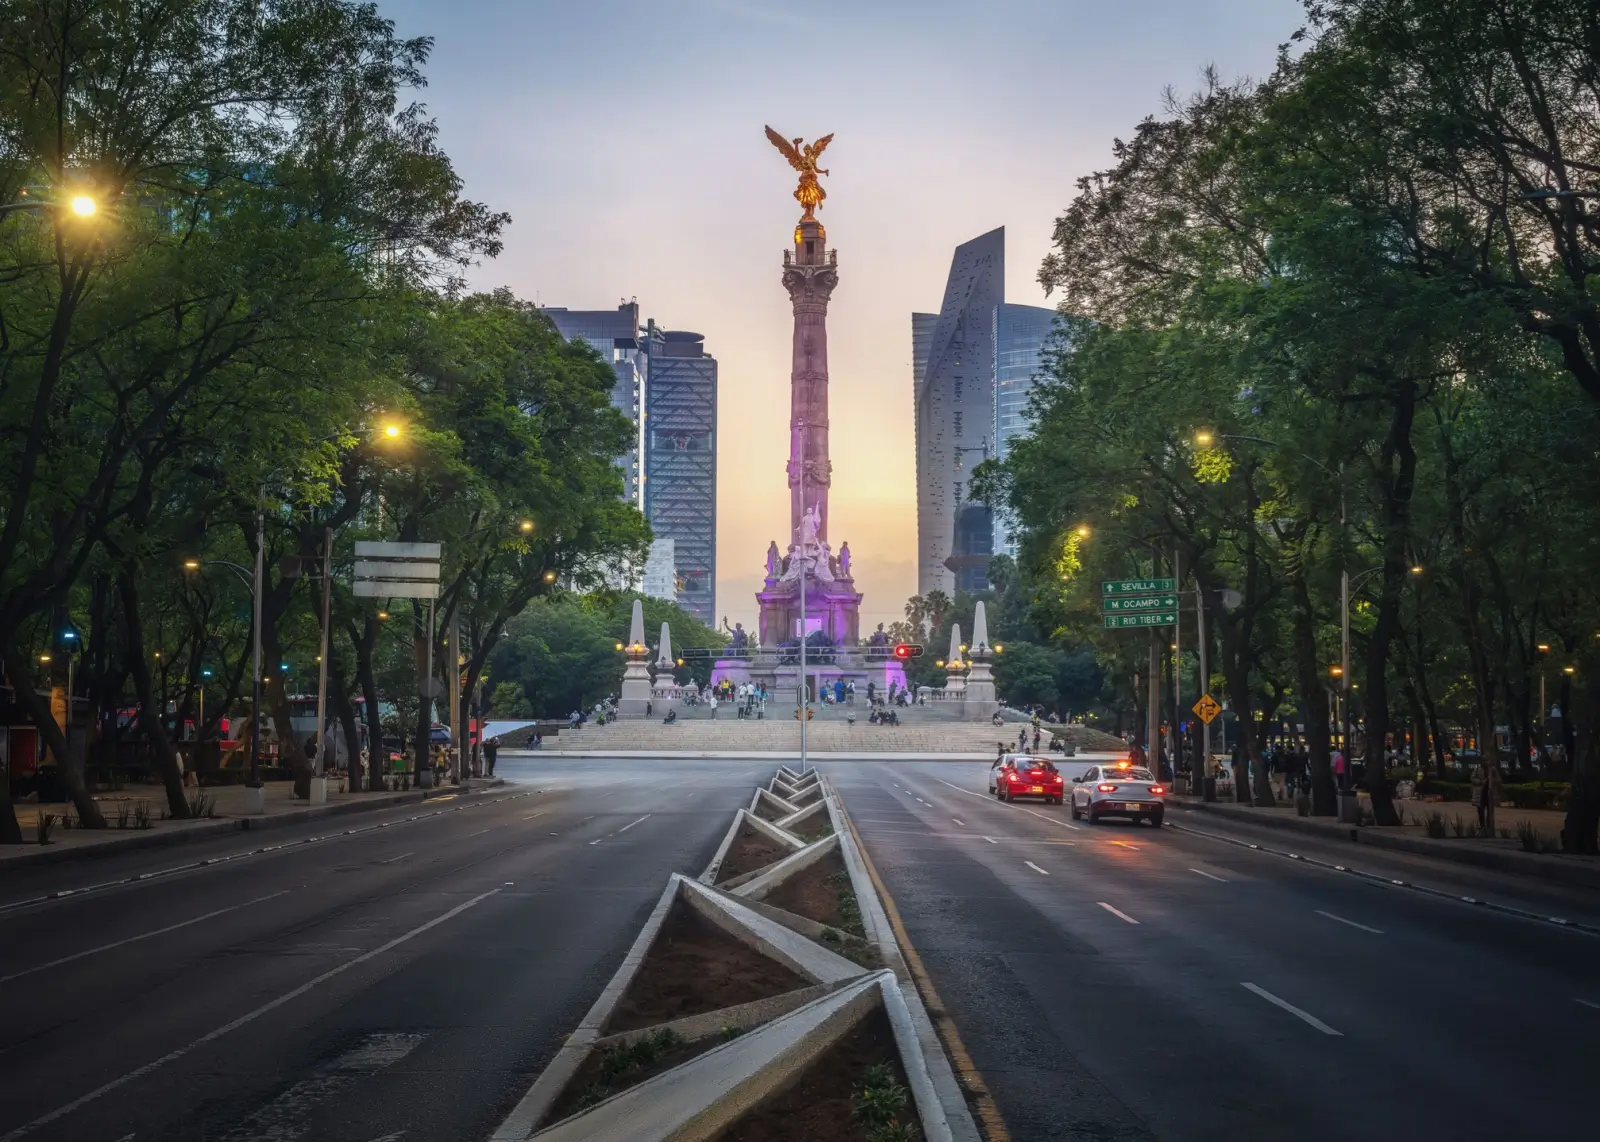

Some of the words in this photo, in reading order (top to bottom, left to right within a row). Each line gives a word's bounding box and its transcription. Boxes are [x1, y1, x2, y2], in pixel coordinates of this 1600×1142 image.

[1121, 582, 1156, 590] SEVILLA
[1123, 599, 1160, 608] OCAMPO
[1140, 616, 1162, 624] TIBER
